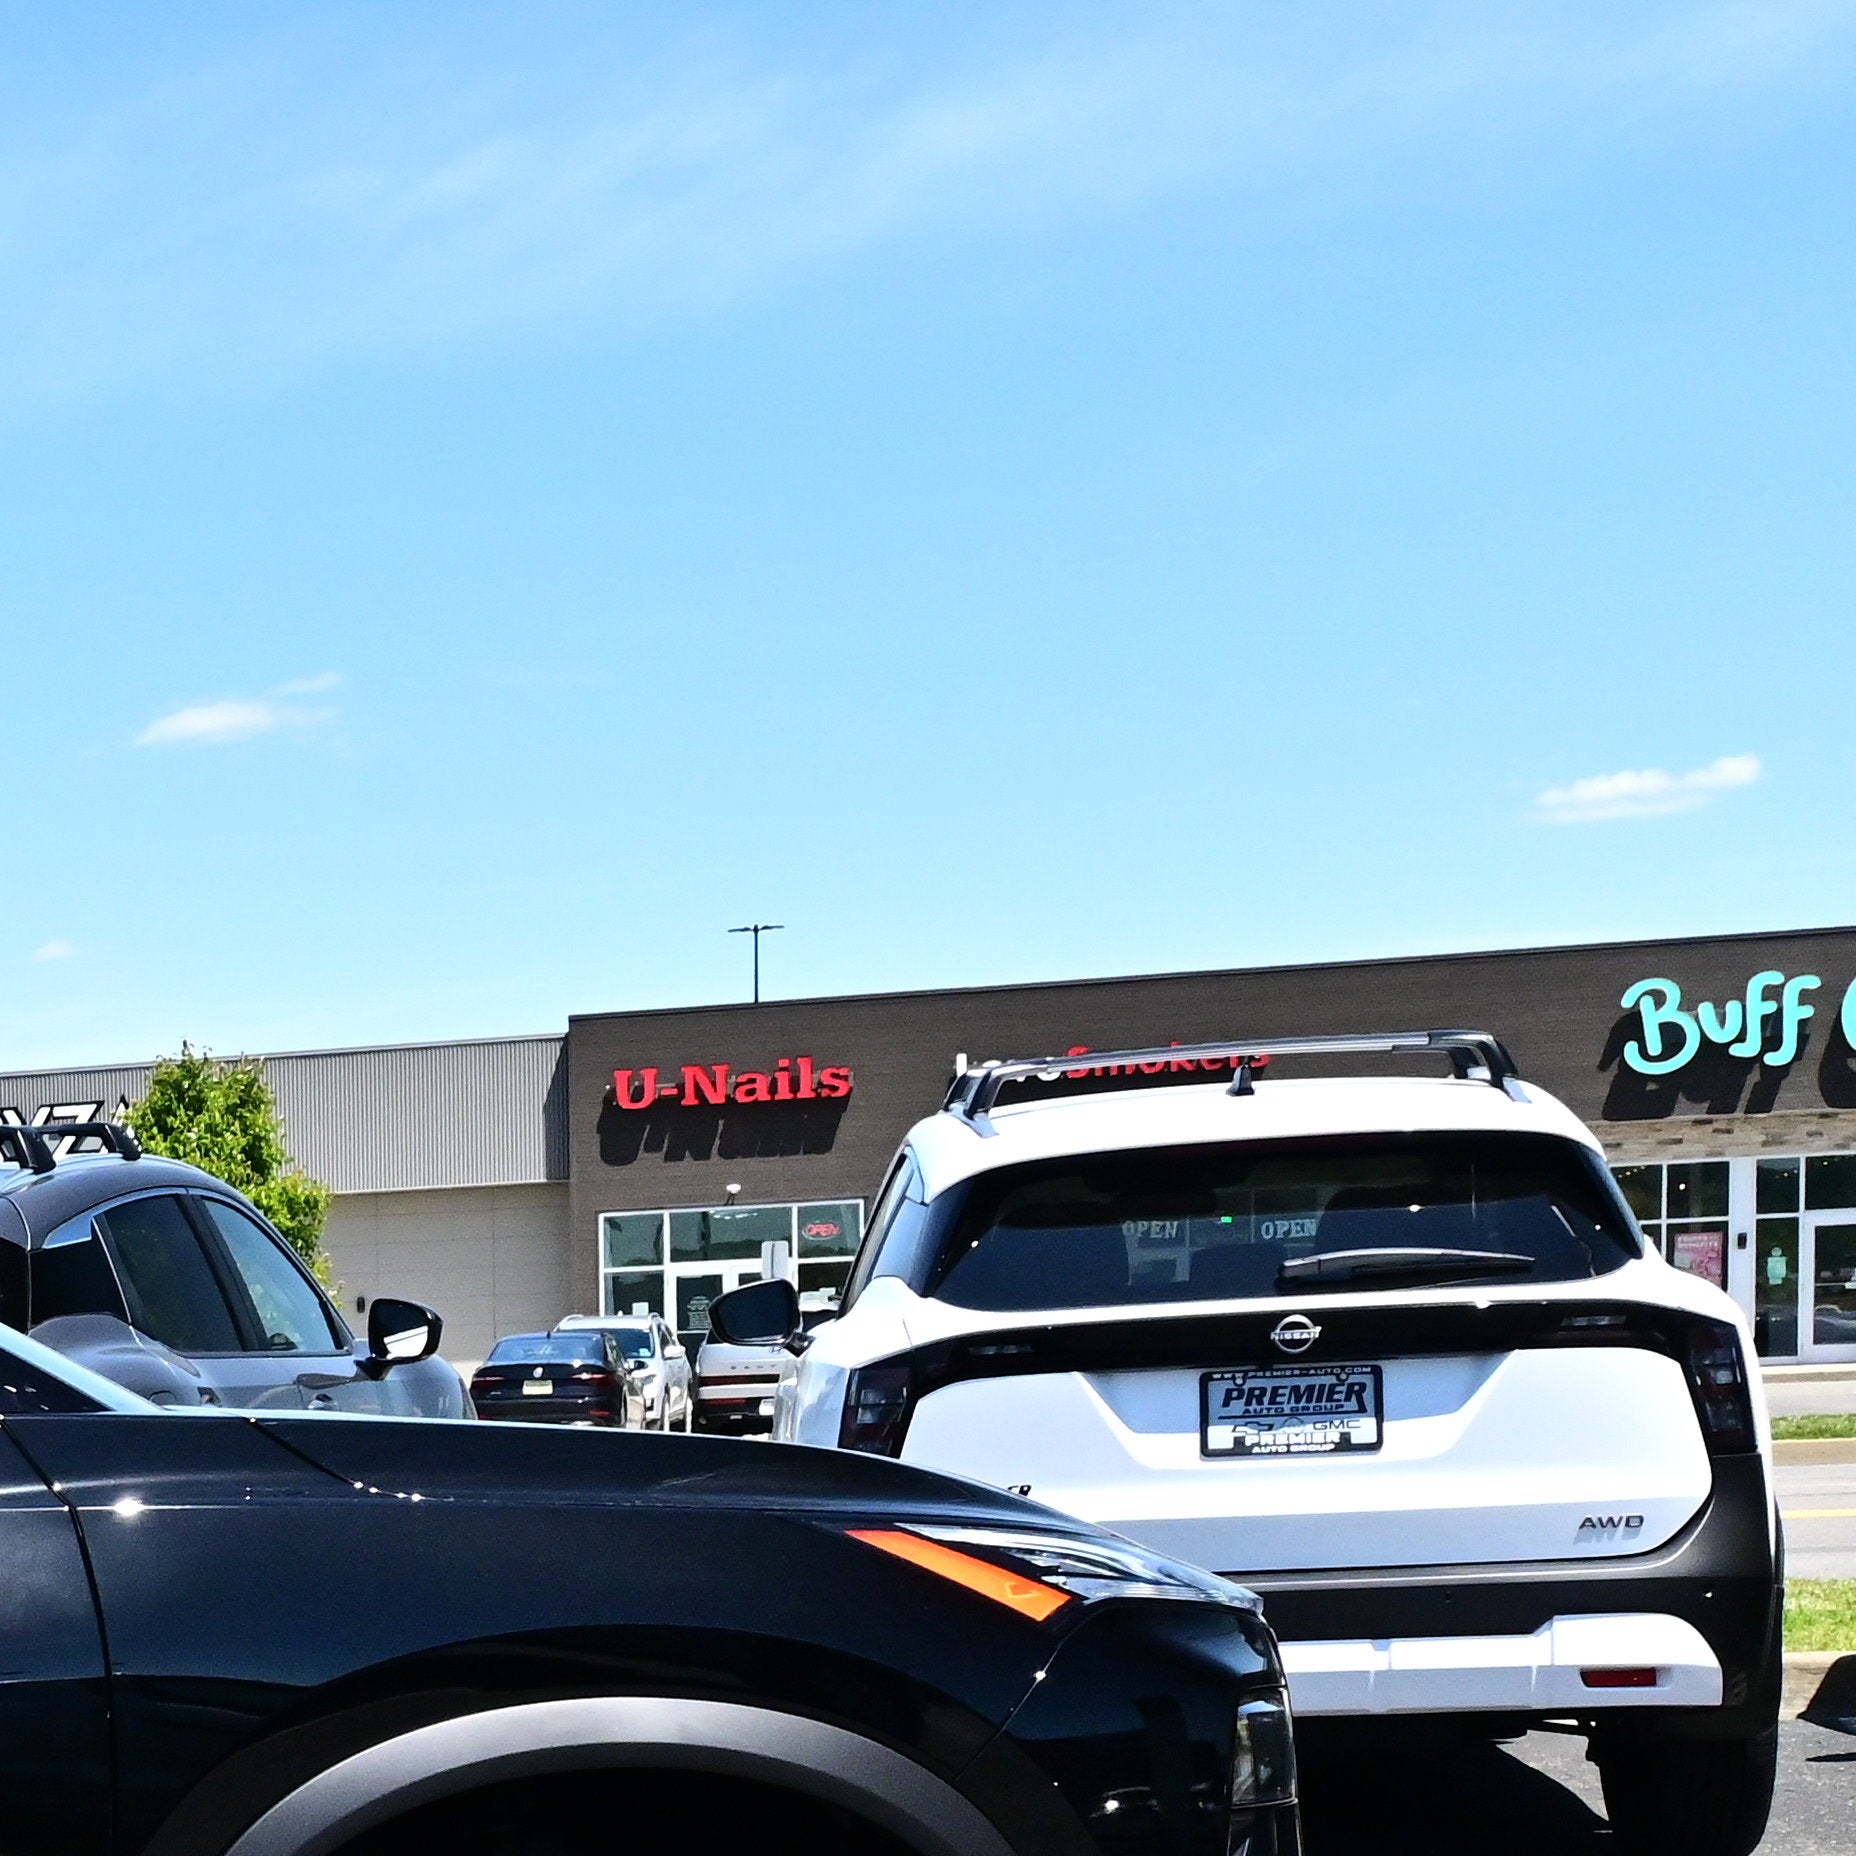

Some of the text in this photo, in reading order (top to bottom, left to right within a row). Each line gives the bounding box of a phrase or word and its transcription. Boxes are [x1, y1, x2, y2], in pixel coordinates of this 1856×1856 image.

[1620, 970, 1822, 1075] Buff
[612, 1056, 853, 1110] U-Nails
[1121, 1220, 1179, 1239] OPEN
[1261, 1218, 1318, 1240] OPEN
[1270, 1329, 1321, 1341] NISSAN
[1221, 1381, 1368, 1413] PREMIER
[1241, 1403, 1346, 1415] AUTO GROUP
[1312, 1419, 1361, 1431] GMC
[1244, 1430, 1342, 1446] PREMIER
[1578, 1515, 1645, 1529] AWD
